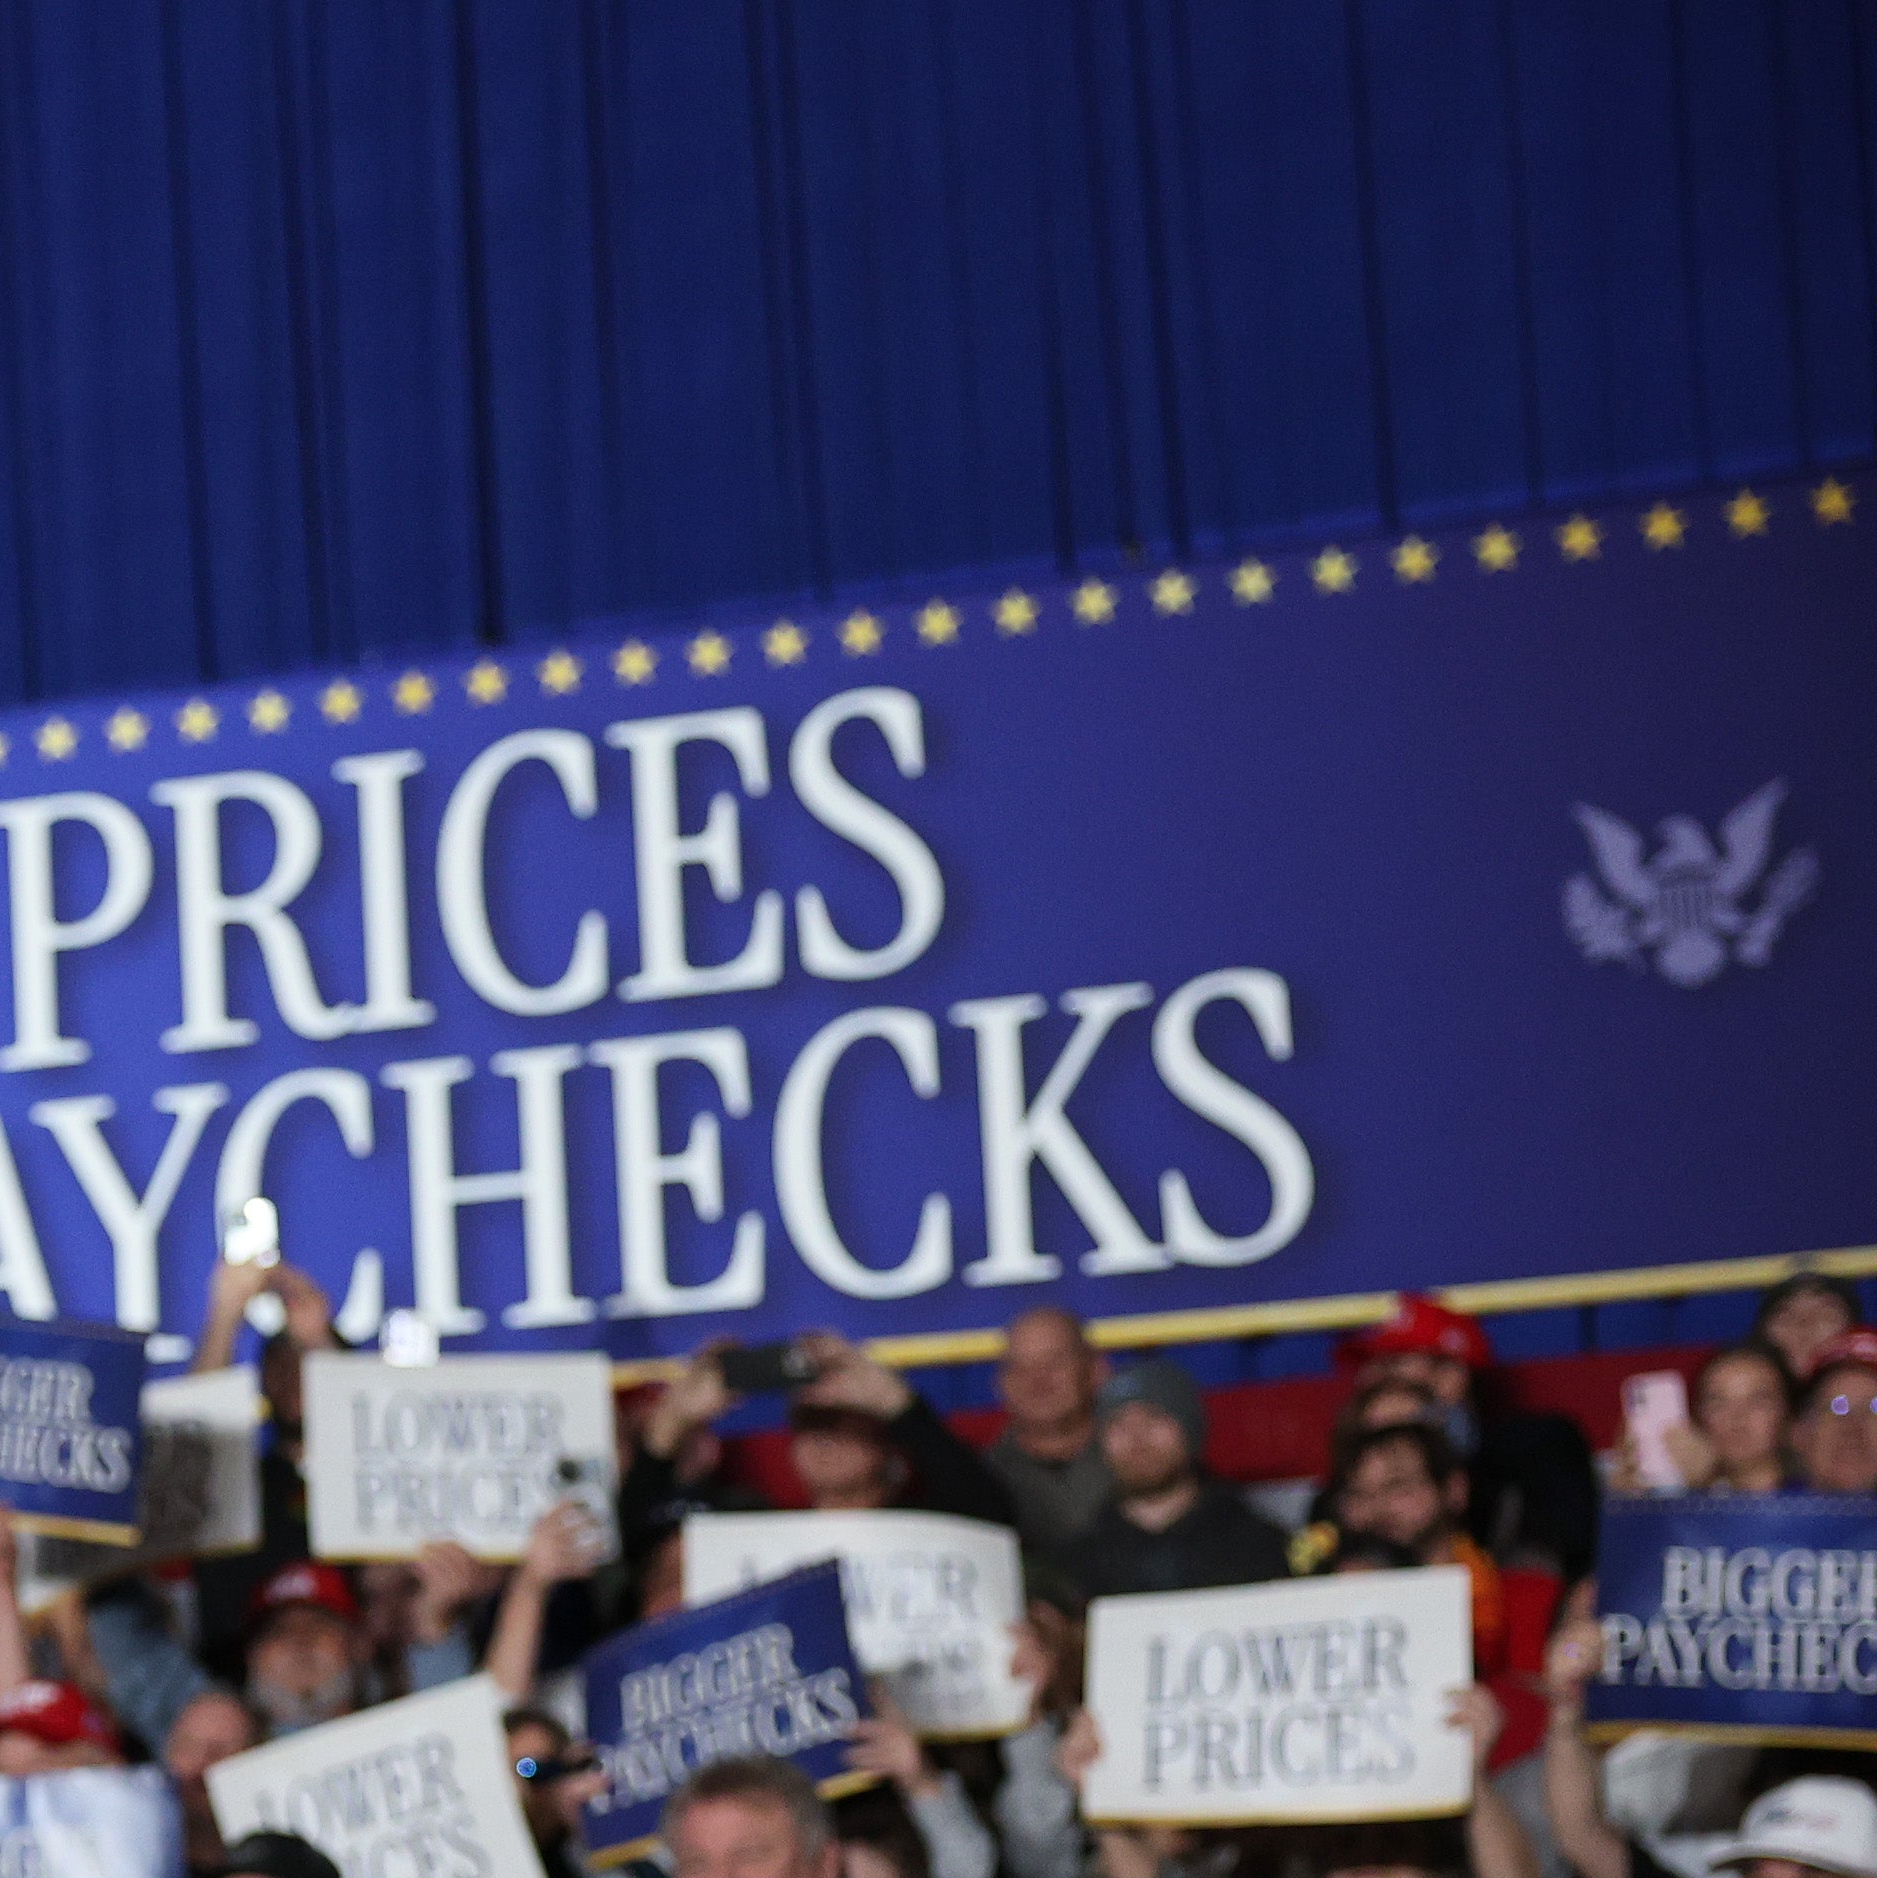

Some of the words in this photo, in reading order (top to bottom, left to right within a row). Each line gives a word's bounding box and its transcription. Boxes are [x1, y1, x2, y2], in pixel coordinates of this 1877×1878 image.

[350, 1388, 567, 1458] LOWER
[353, 1460, 557, 1536] PRICE
[618, 1621, 801, 1740] BIGGER
[1147, 1612, 1411, 1710] LOWER
[1599, 1610, 1877, 1696] PAYCHEC
[1142, 1700, 1417, 1796] PRICES
